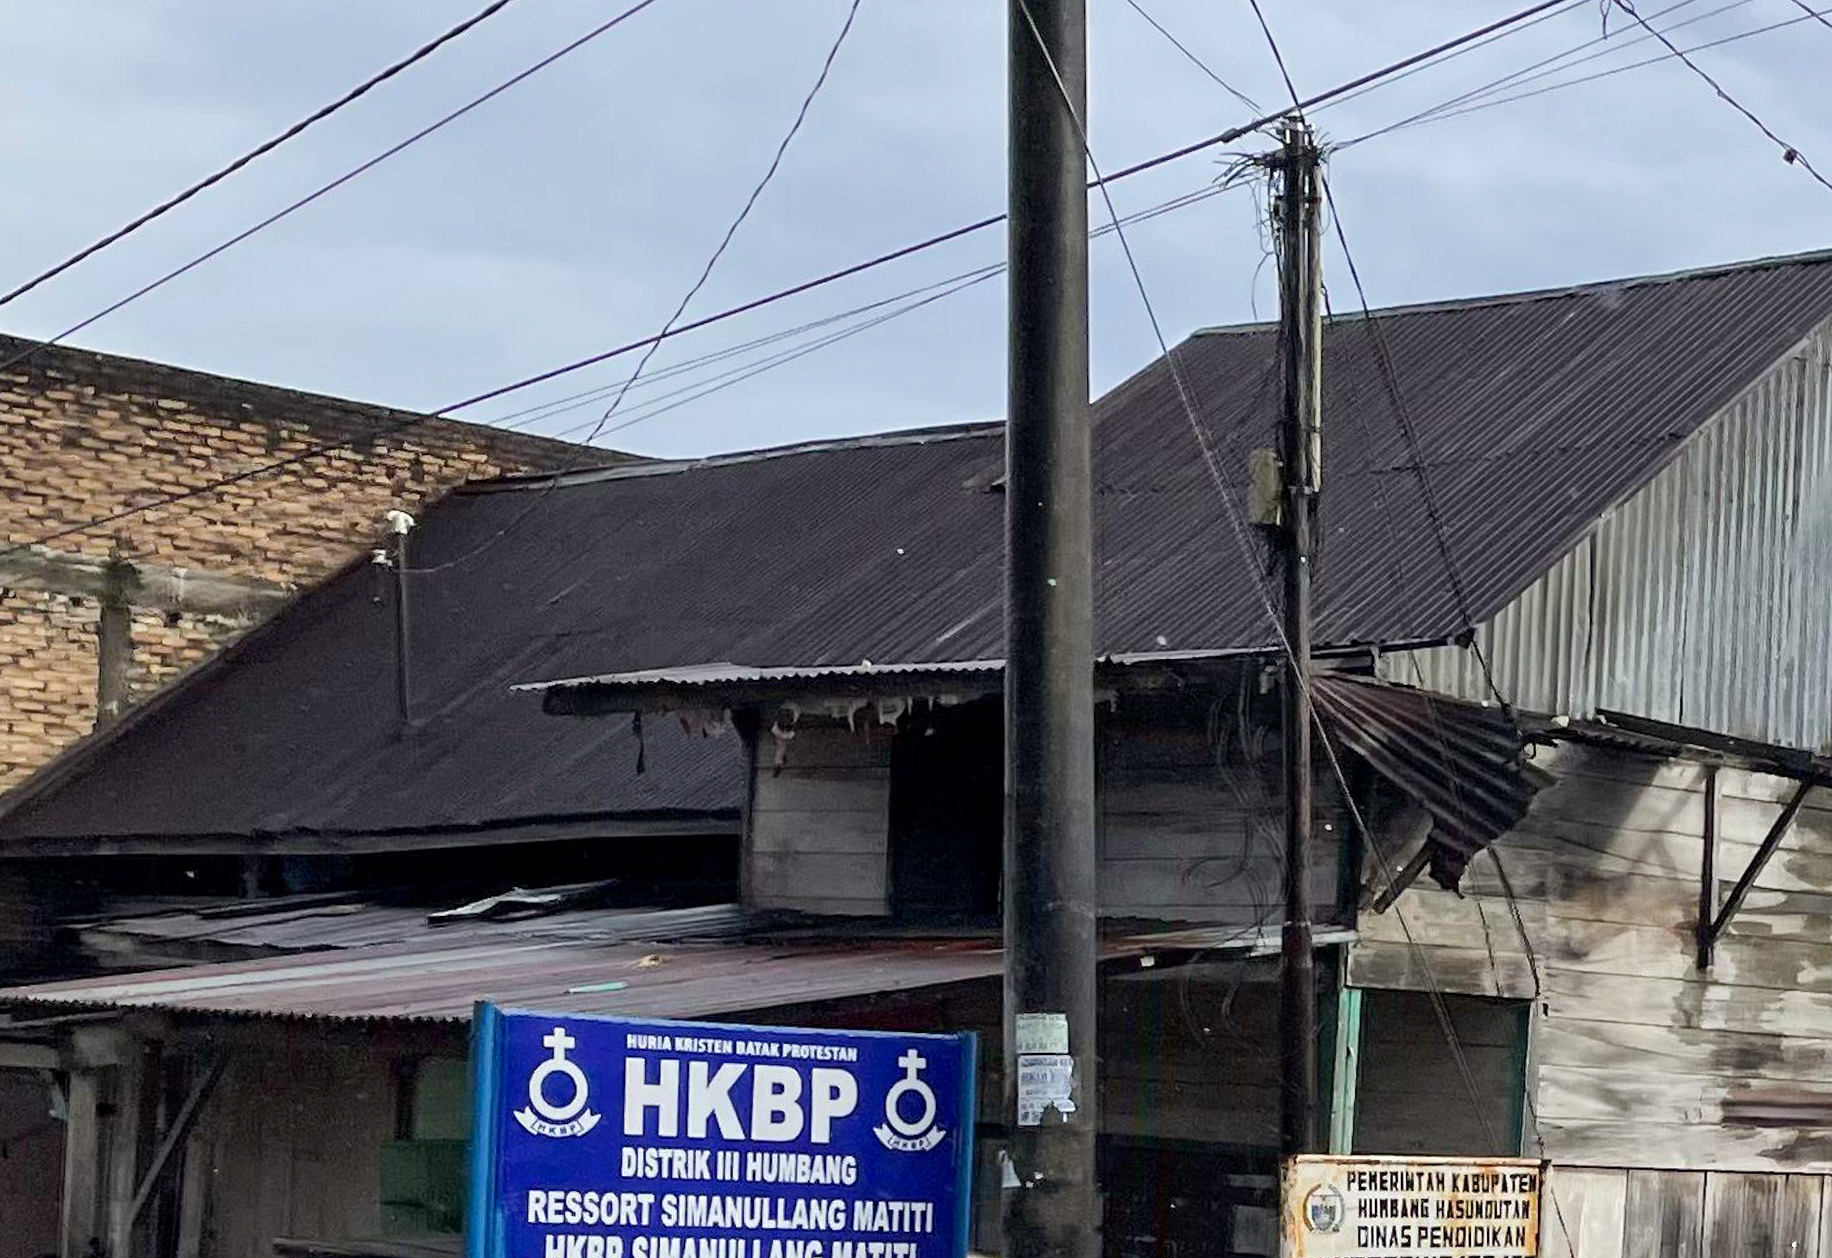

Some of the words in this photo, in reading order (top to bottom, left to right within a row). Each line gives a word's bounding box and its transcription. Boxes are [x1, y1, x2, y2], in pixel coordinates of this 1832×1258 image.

[626, 1033, 672, 1052] HURIA
[674, 1036, 733, 1054] KRISTEN
[735, 1041, 781, 1057] BATAK
[782, 1045, 858, 1062] PROTESTAN
[622, 1057, 859, 1144] HKBP
[537, 1123, 577, 1135] HKBP
[621, 1146, 710, 1180] DISTRIK
[716, 1153, 740, 1181] III
[746, 1154, 857, 1186] HUMBANG
[1346, 1171, 1446, 1192] PEMERINTAH
[1451, 1173, 1538, 1195] KABUPATEN
[527, 1190, 655, 1226] RESSORT
[660, 1193, 846, 1232] SIMANULLANG
[853, 1200, 934, 1234] MATITI
[1358, 1199, 1429, 1219] HUMBANG
[1357, 1226, 1412, 1248] DINAS
[1417, 1227, 1526, 1249] PENDIDIKAN
